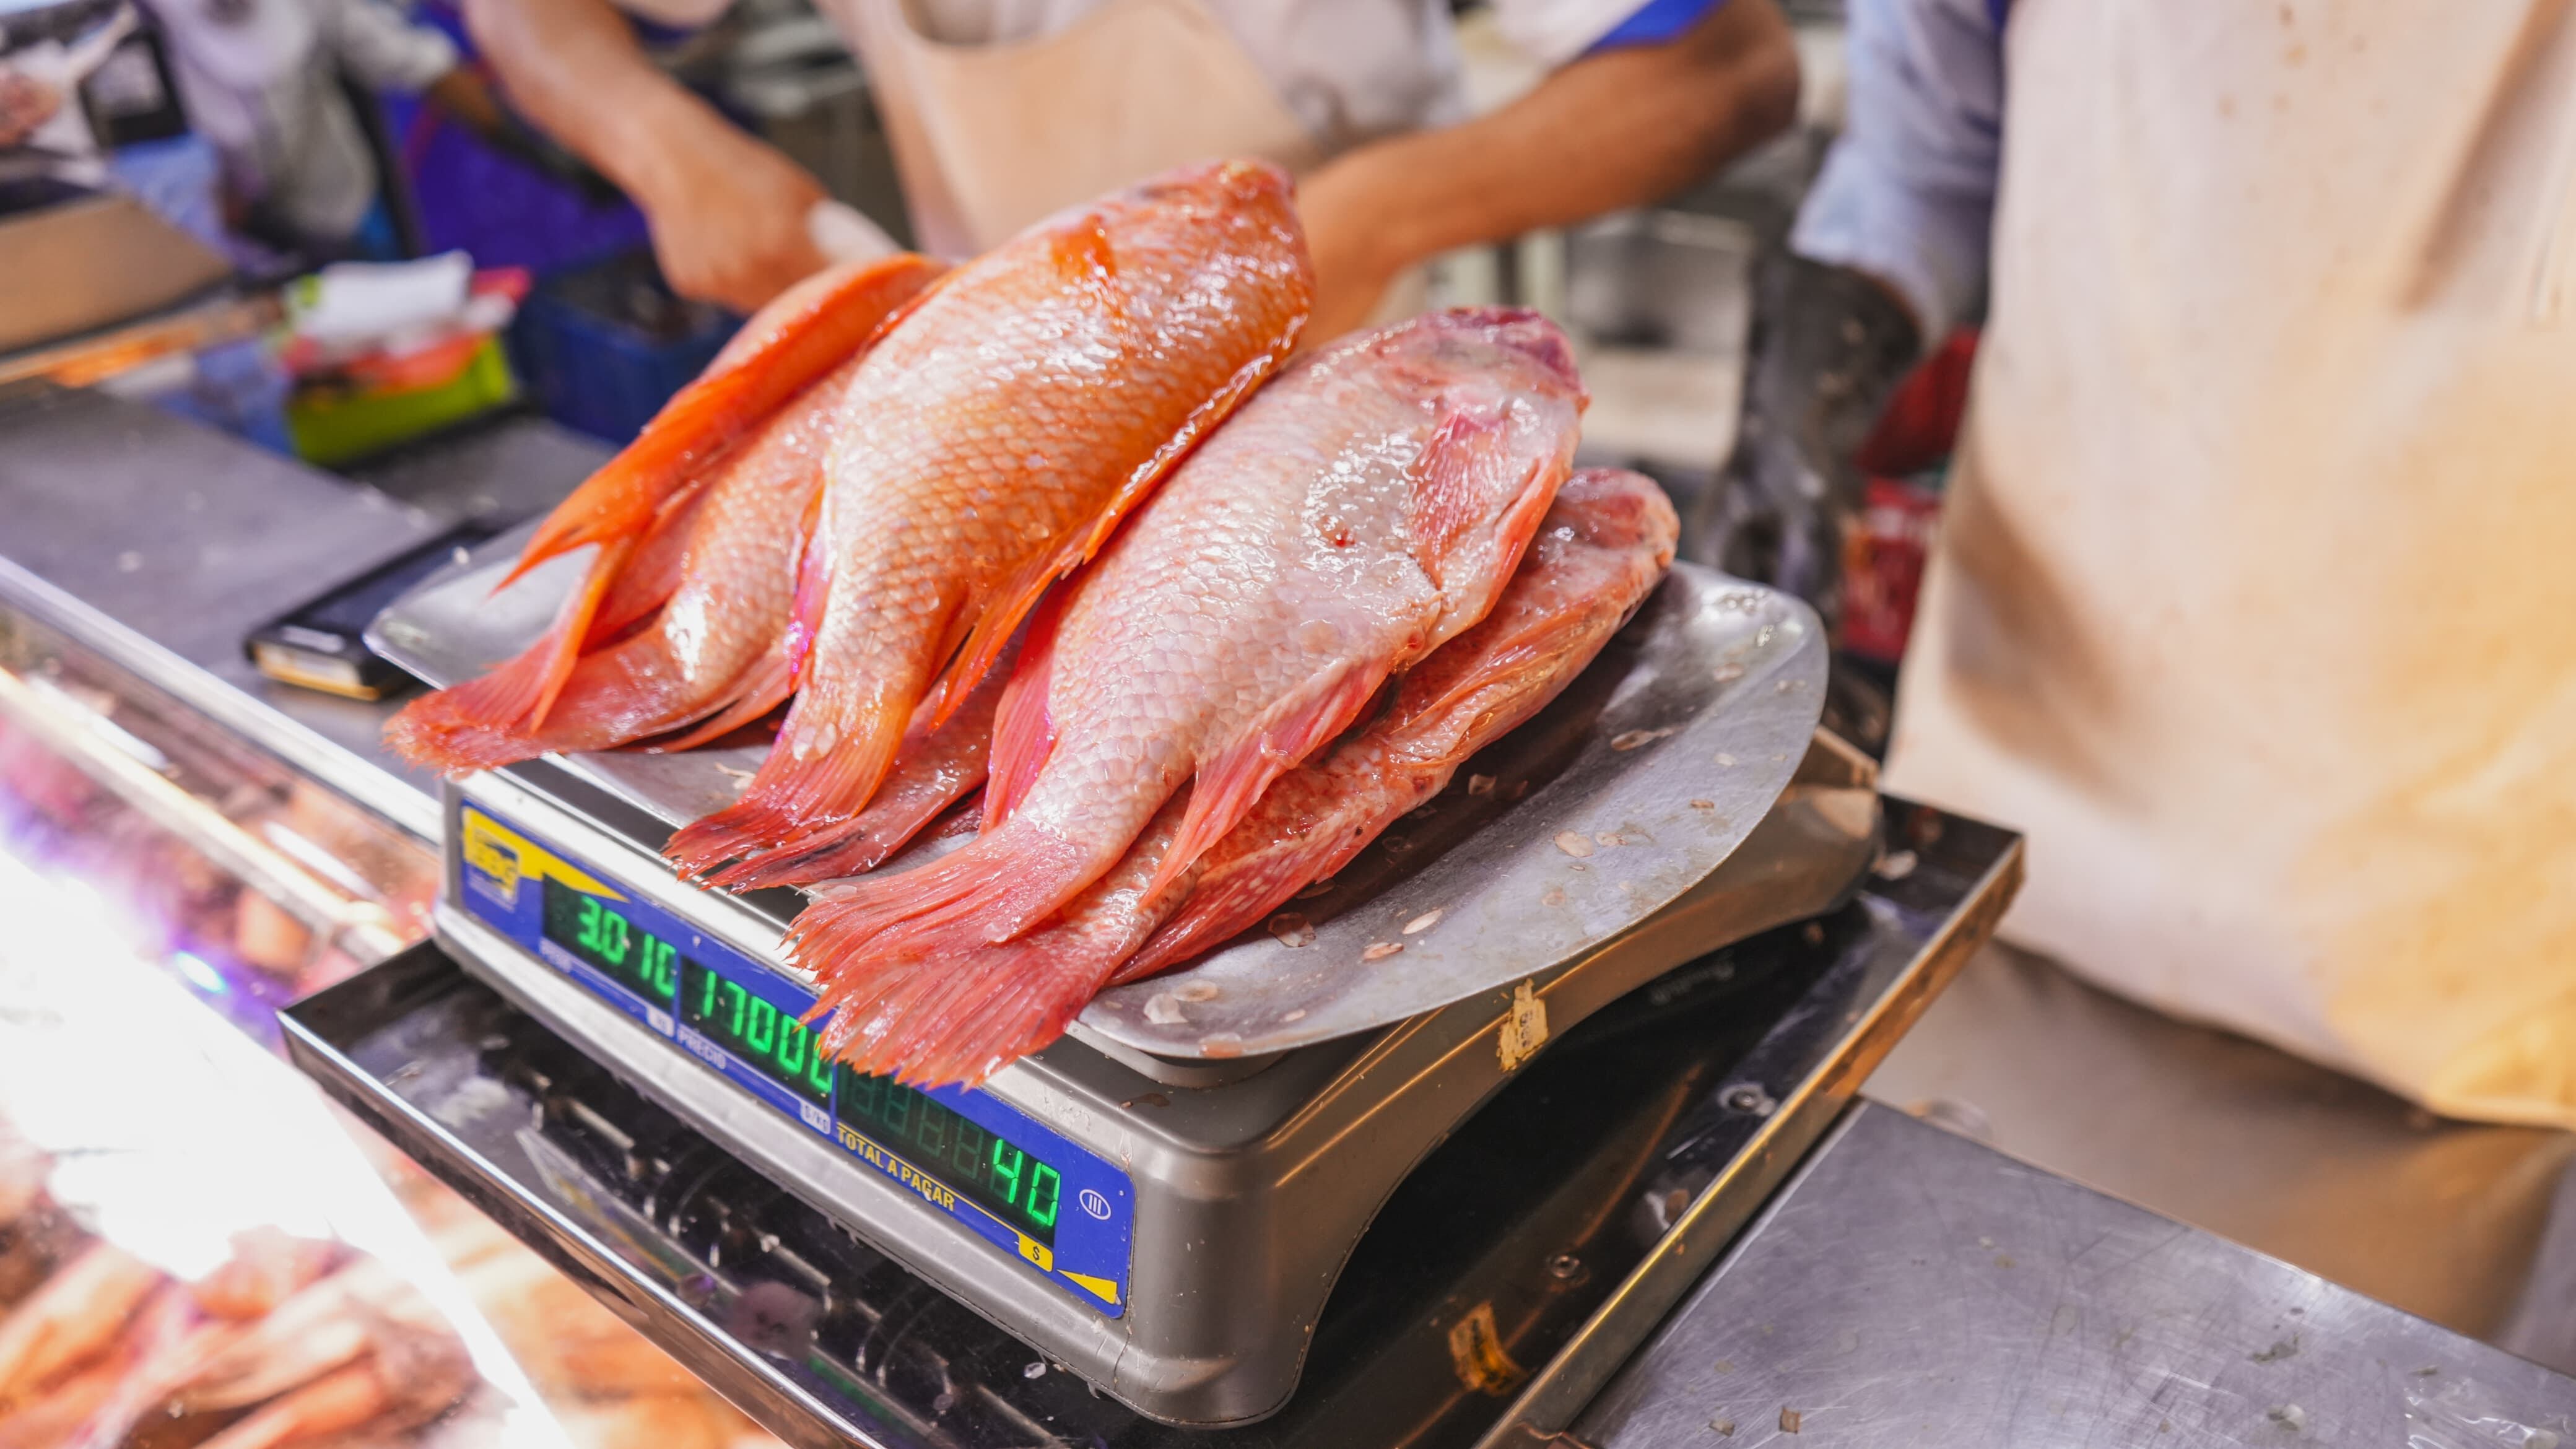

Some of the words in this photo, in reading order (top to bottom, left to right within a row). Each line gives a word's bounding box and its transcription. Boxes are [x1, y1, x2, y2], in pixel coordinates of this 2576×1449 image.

[677, 1027, 726, 1069] PRECIO
[837, 1127, 884, 1169] TOTAL
[887, 1159, 898, 1177] A
[901, 1166, 955, 1212] PAGAR
[993, 1139, 1061, 1227] 40
[1032, 1245, 1040, 1261] $
